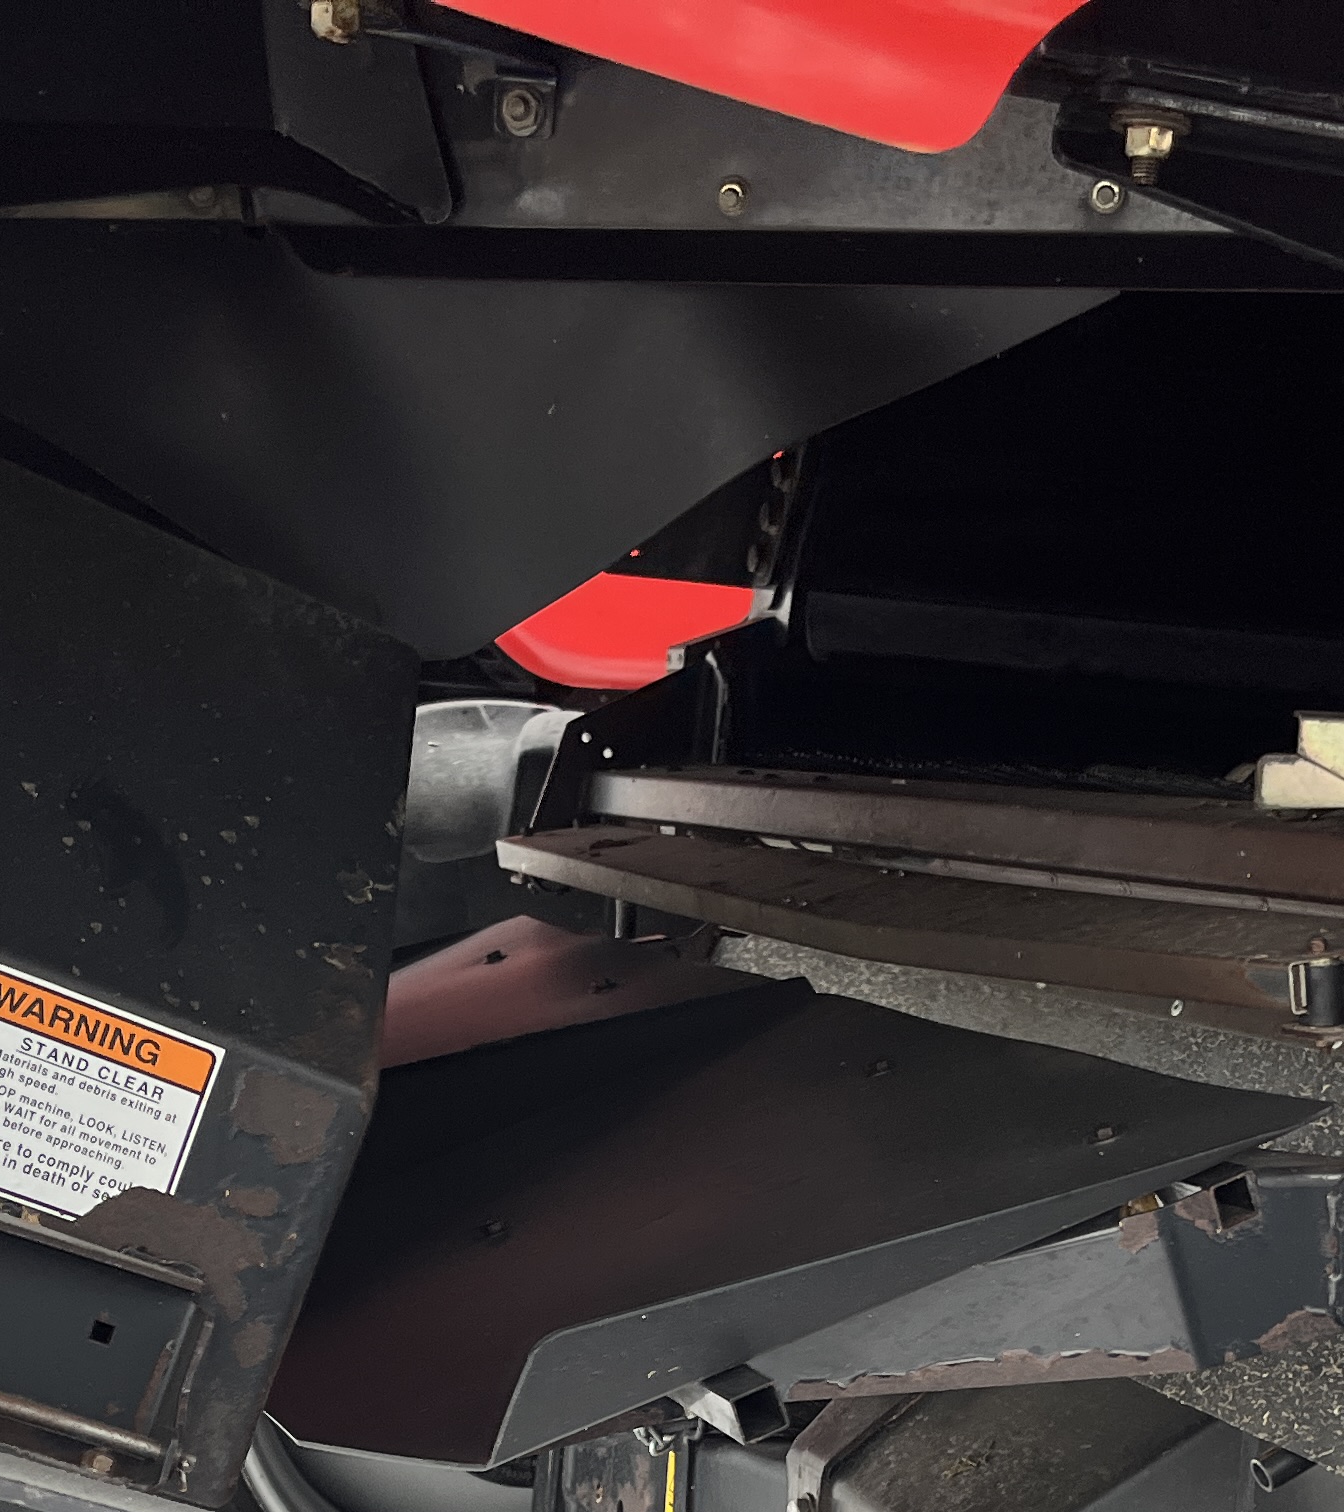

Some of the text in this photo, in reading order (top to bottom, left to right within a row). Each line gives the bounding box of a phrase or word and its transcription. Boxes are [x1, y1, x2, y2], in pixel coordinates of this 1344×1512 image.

[20, 1037, 164, 1100] STAND CLEAR
[53, 1072, 75, 1086] and
[79, 1080, 116, 1102] debris
[121, 1096, 161, 1120] exiting
[165, 1113, 177, 1124] at
[3, 1117, 42, 1138] before
[5, 1102, 37, 1121] WAIT
[40, 1115, 57, 1129] for
[60, 1122, 75, 1136] all
[80, 1131, 147, 1159] movement
[145, 1154, 156, 1165] to
[3, 1156, 16, 1169] in
[23, 1162, 66, 1187] death
[71, 1182, 88, 1194] or
[18, 1143, 32, 1158] to
[38, 1154, 94, 1181] comply
